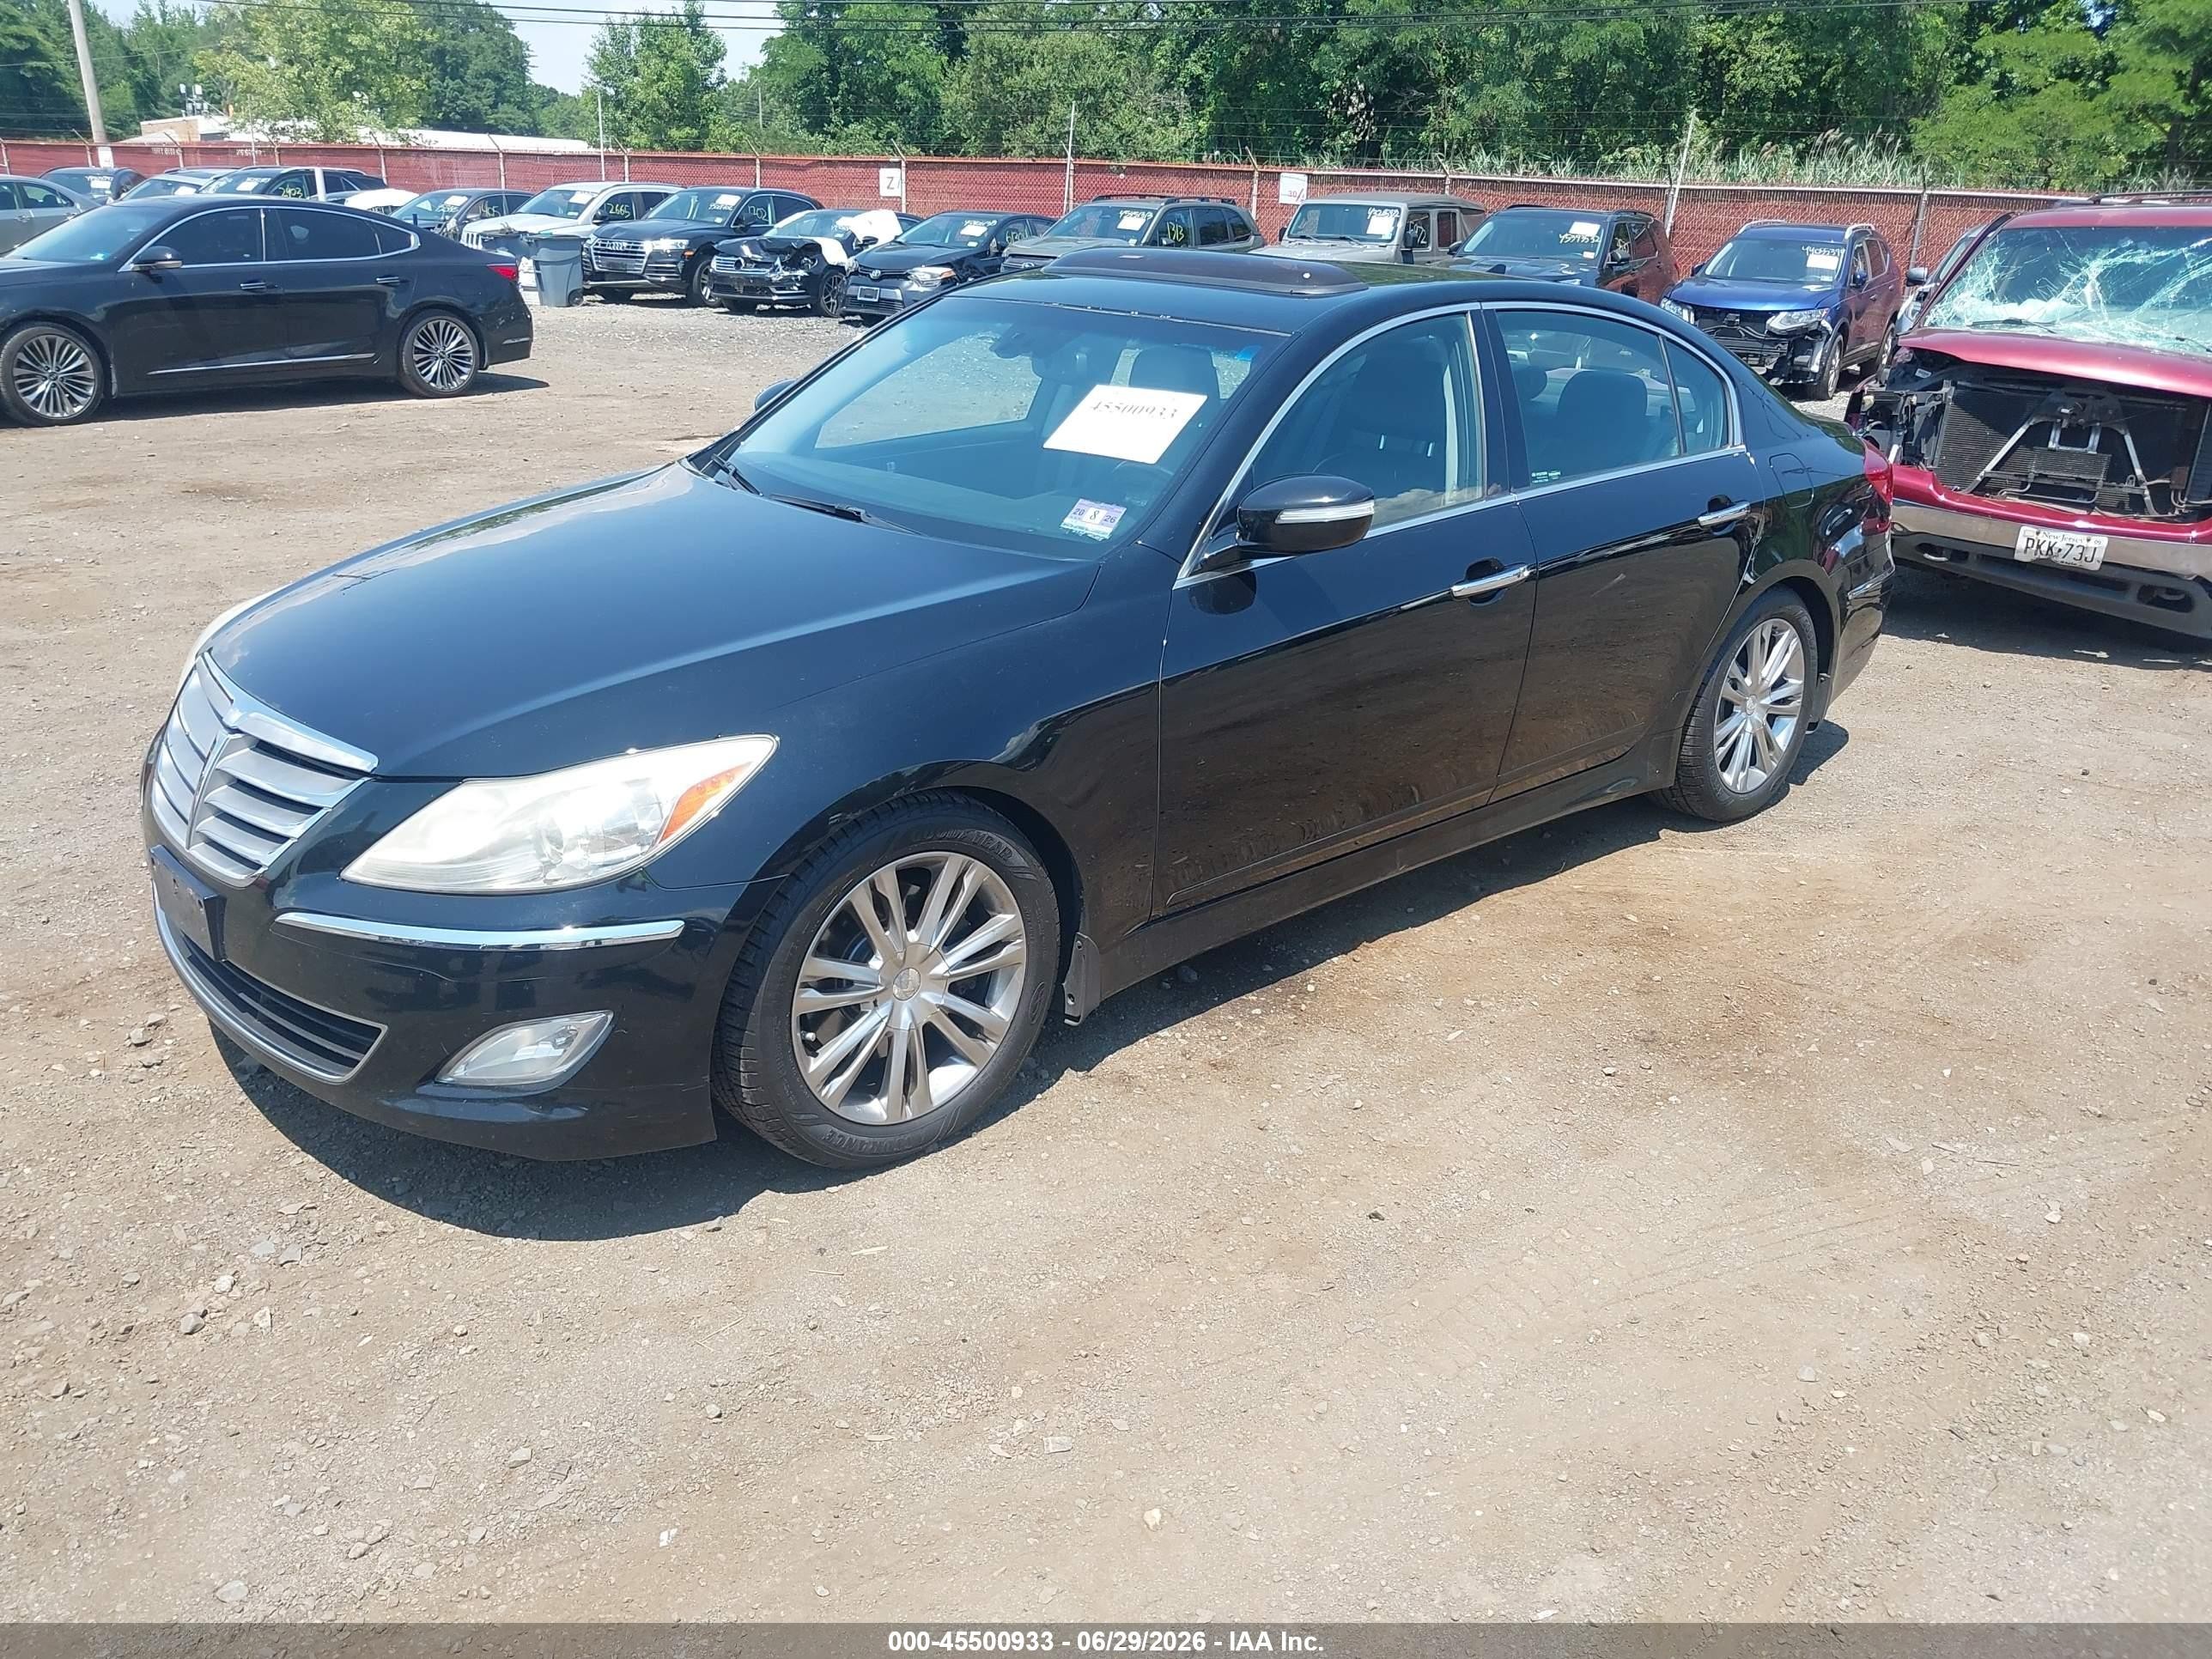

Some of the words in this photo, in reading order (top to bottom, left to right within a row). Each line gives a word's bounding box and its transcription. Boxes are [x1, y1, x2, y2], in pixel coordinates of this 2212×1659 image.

[1073, 507, 1085, 516] 20
[1089, 509, 1100, 520] 8
[1103, 514, 1116, 524] 26
